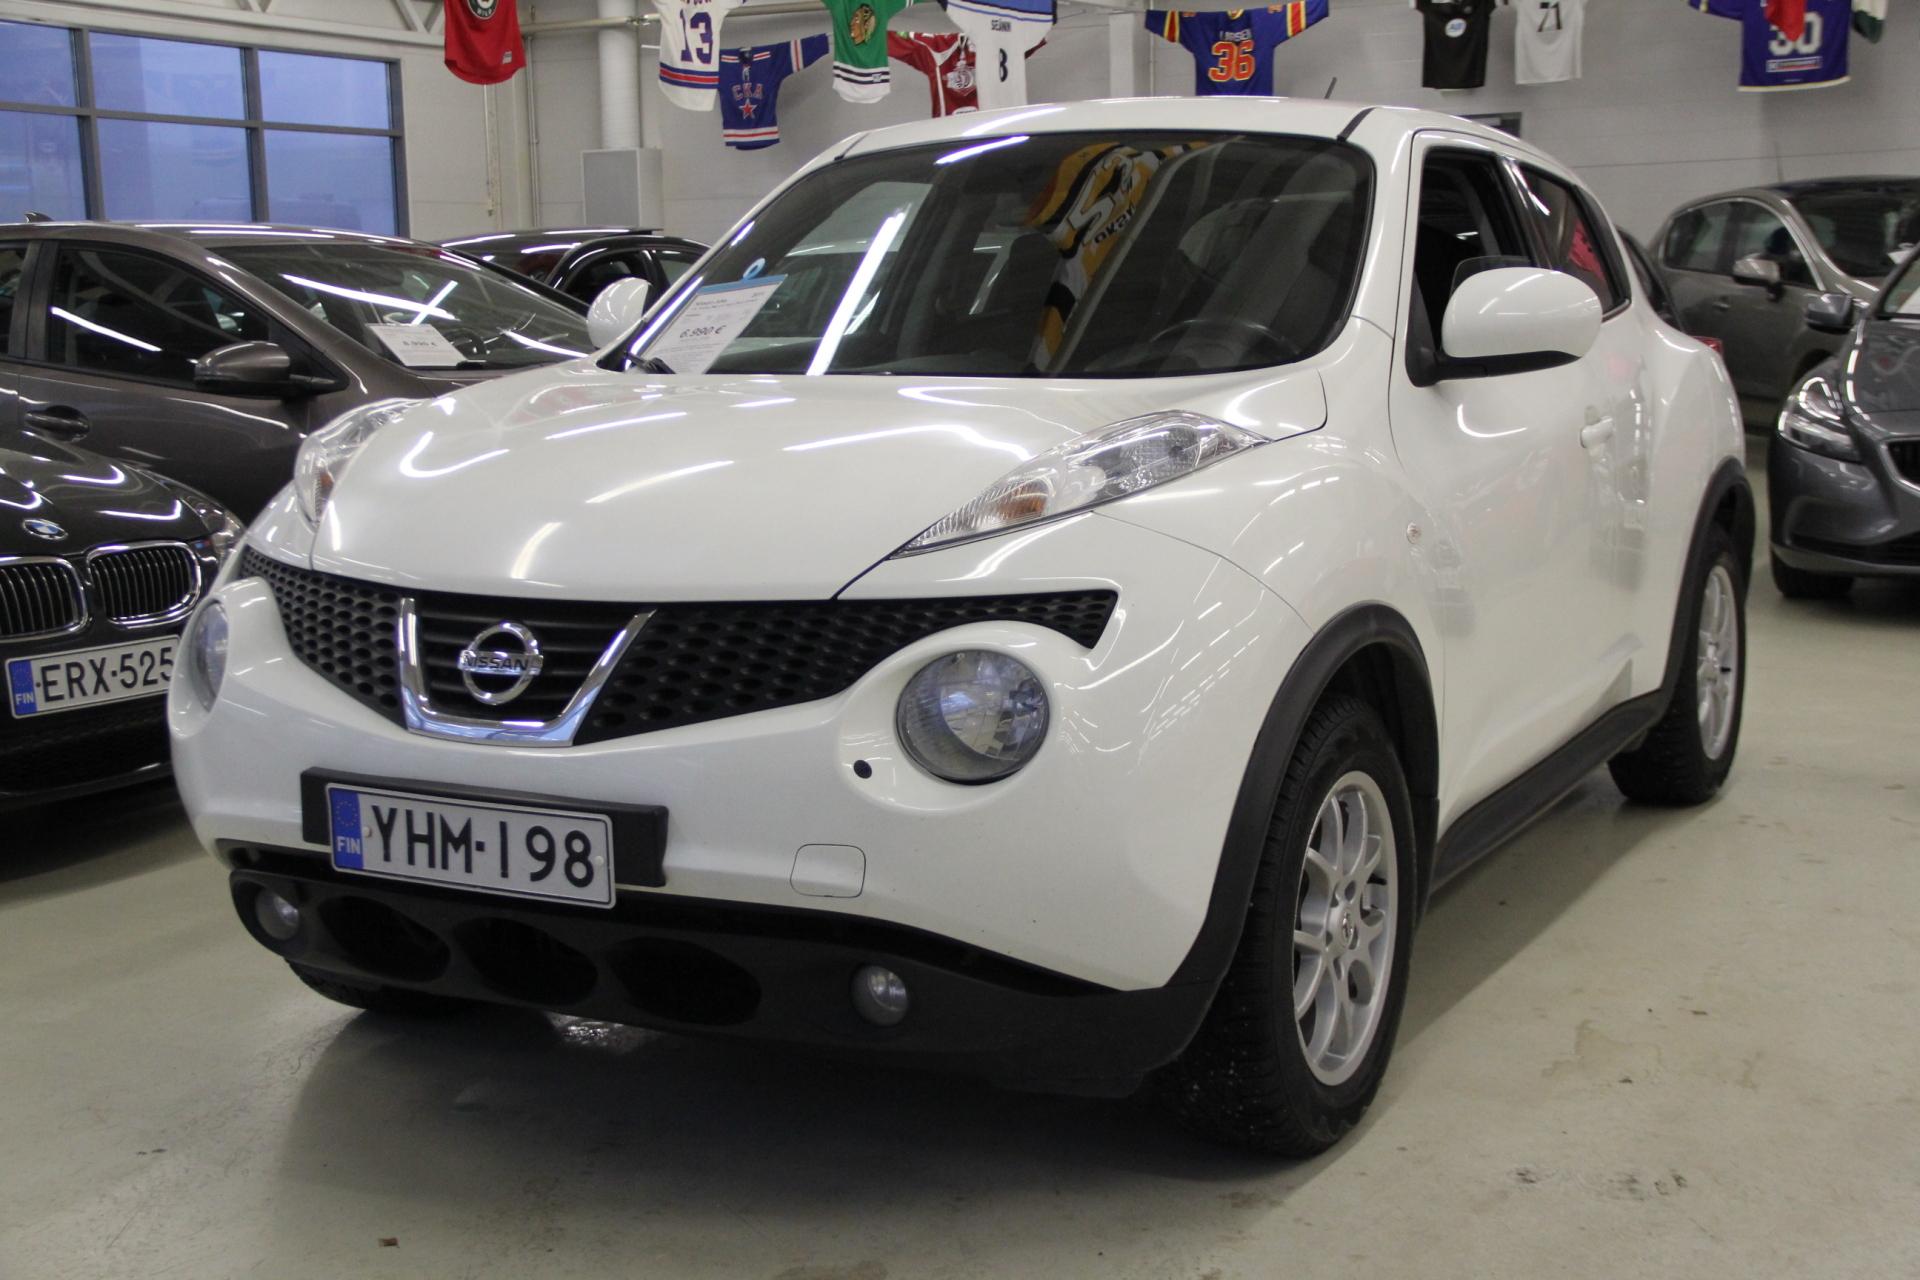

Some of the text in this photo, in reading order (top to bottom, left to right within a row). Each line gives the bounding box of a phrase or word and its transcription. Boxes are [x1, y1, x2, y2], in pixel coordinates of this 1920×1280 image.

[680, 9, 714, 65] 13
[1537, 1, 1563, 33] 71
[1768, 12, 1823, 56] 30
[1208, 40, 1255, 81] 36
[40, 646, 176, 703] ERX-525
[464, 654, 529, 671] NISSAN
[15, 692, 35, 705] FIN
[336, 836, 362, 855] FIN
[371, 804, 595, 888] YHM-198
